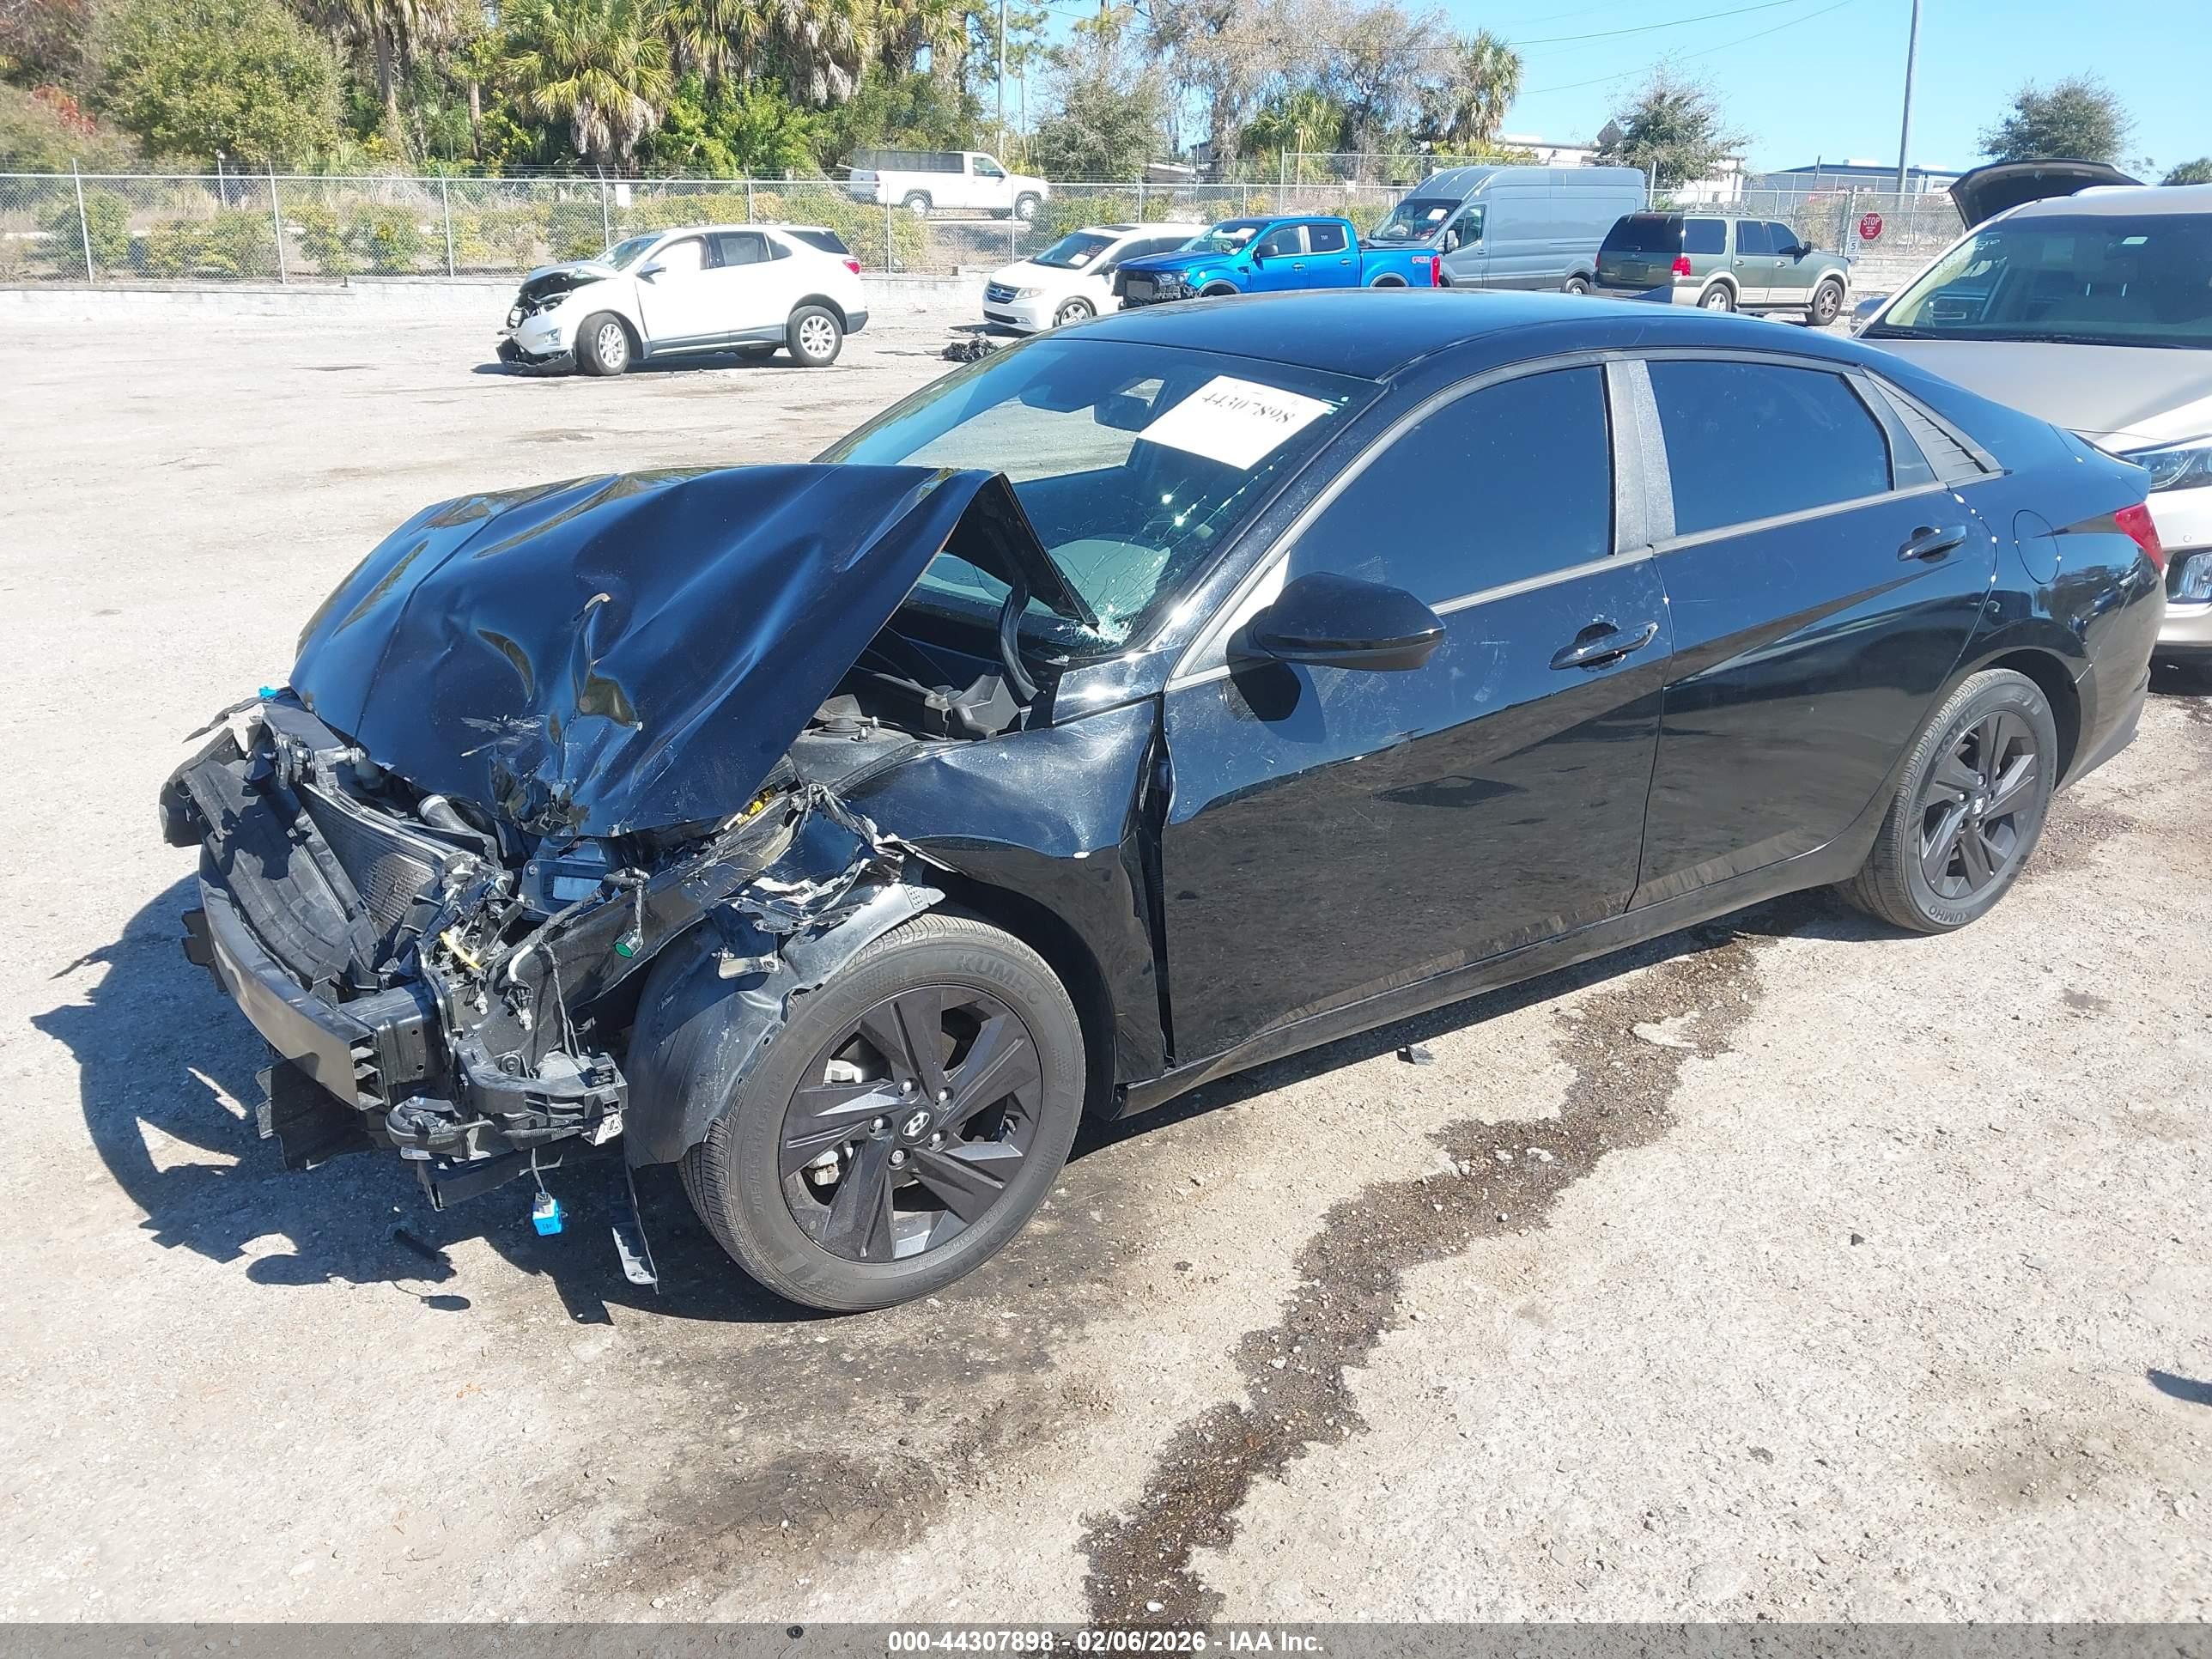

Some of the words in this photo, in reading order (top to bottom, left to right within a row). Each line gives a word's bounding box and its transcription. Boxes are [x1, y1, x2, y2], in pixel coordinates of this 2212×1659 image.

[1863, 216, 1881, 226] STOP
[1201, 392, 1297, 424] 44307898
[1929, 904, 1972, 923] KUMHO
